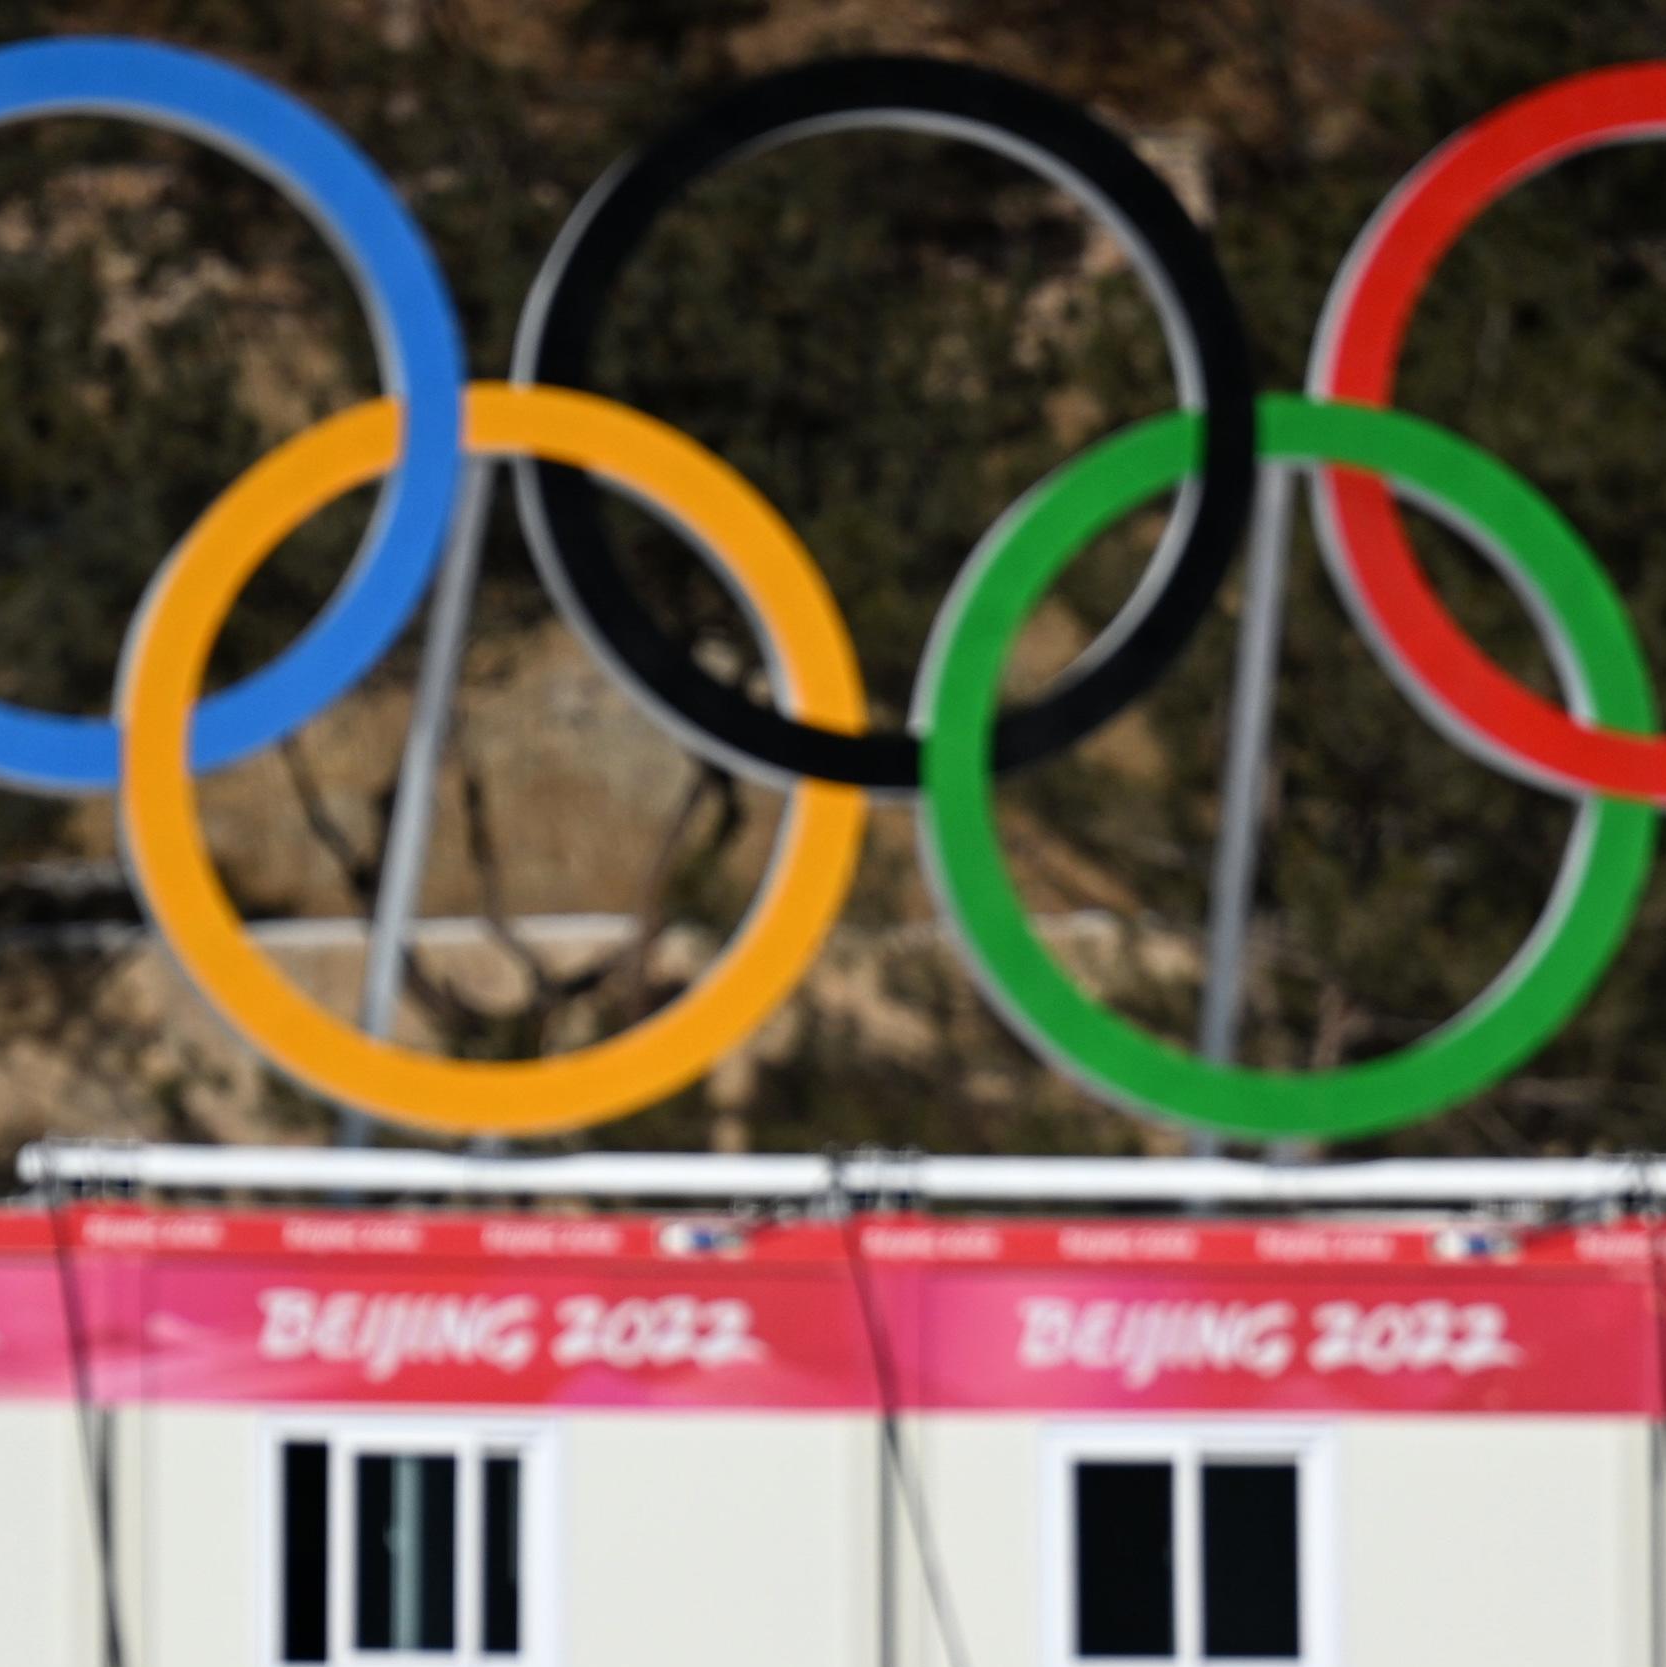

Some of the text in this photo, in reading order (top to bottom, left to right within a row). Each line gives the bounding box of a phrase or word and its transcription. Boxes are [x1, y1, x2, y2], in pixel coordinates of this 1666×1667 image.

[258, 1287, 767, 1380] BEIJING 2022
[1019, 1298, 1527, 1387] BEIJING 2022
